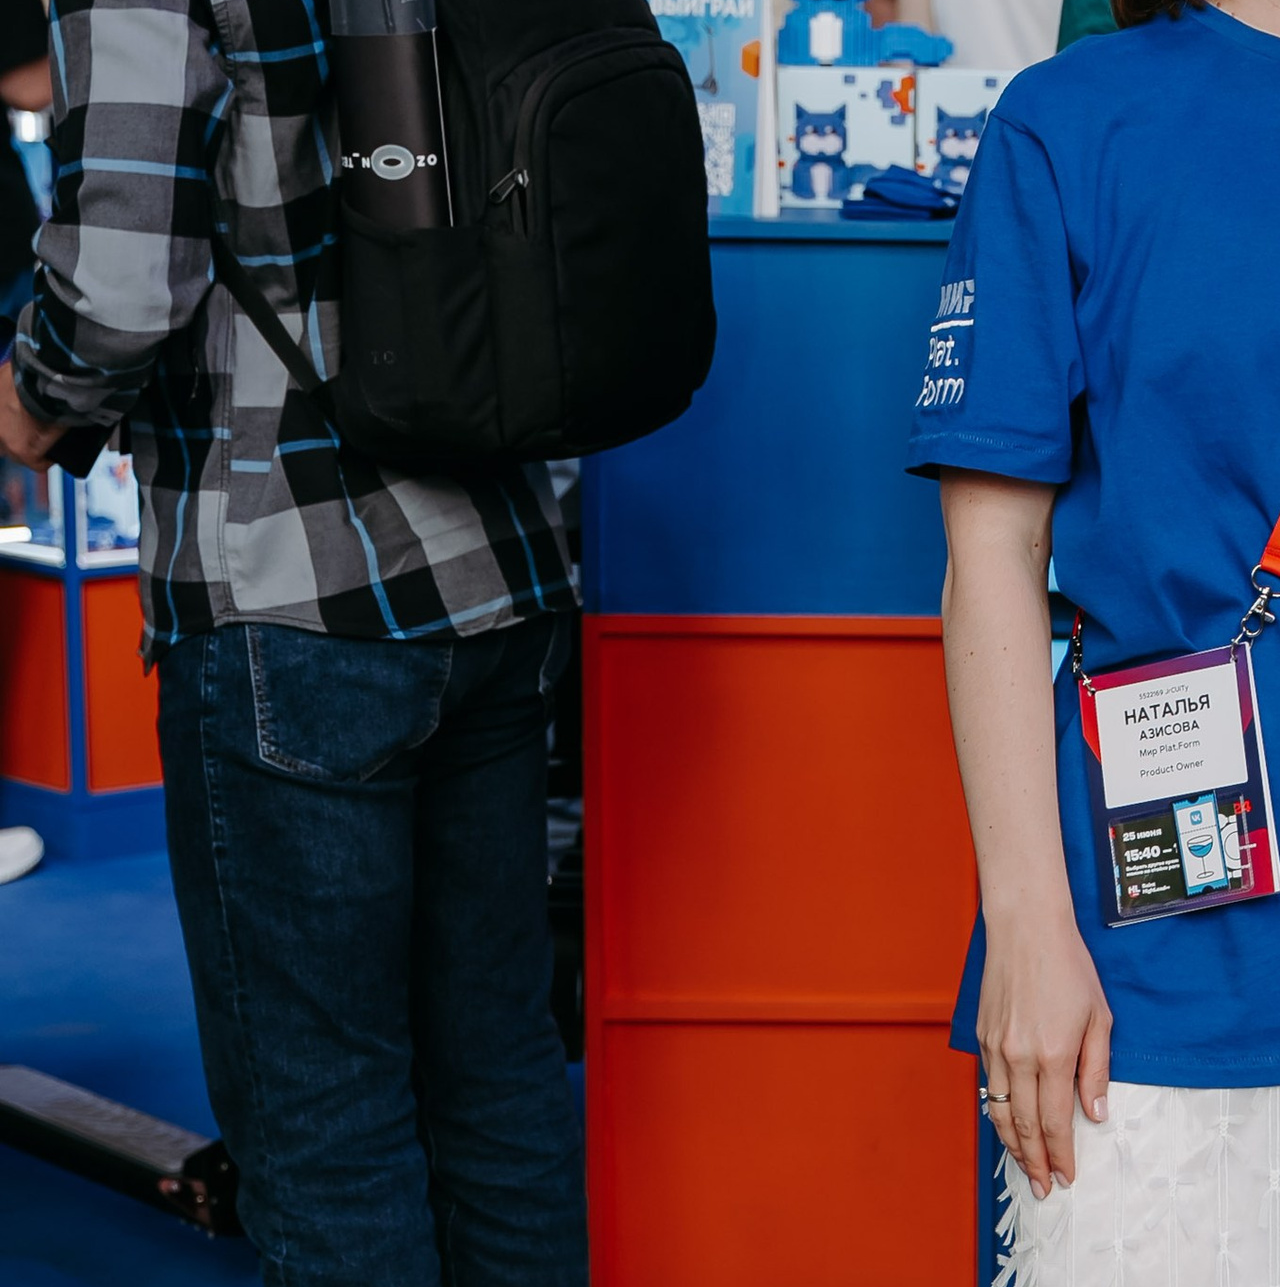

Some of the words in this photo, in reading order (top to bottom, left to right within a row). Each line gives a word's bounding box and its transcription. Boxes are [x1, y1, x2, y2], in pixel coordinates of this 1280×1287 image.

[925, 334, 959, 370] Plat.
[915, 375, 965, 407] Form
[1124, 693, 1211, 725] НАТАЛЬЯ
[1139, 719, 1200, 741] АЗИСОВА
[1139, 747, 1158, 758] Мир
[1159, 739, 1201, 754] Plat.Form
[1140, 764, 1174, 778] Product
[1176, 758, 1204, 771] Owner
[1122, 831, 1136, 842] 25
[1136, 828, 1162, 840] июня
[1124, 845, 1161, 863] 15:40
